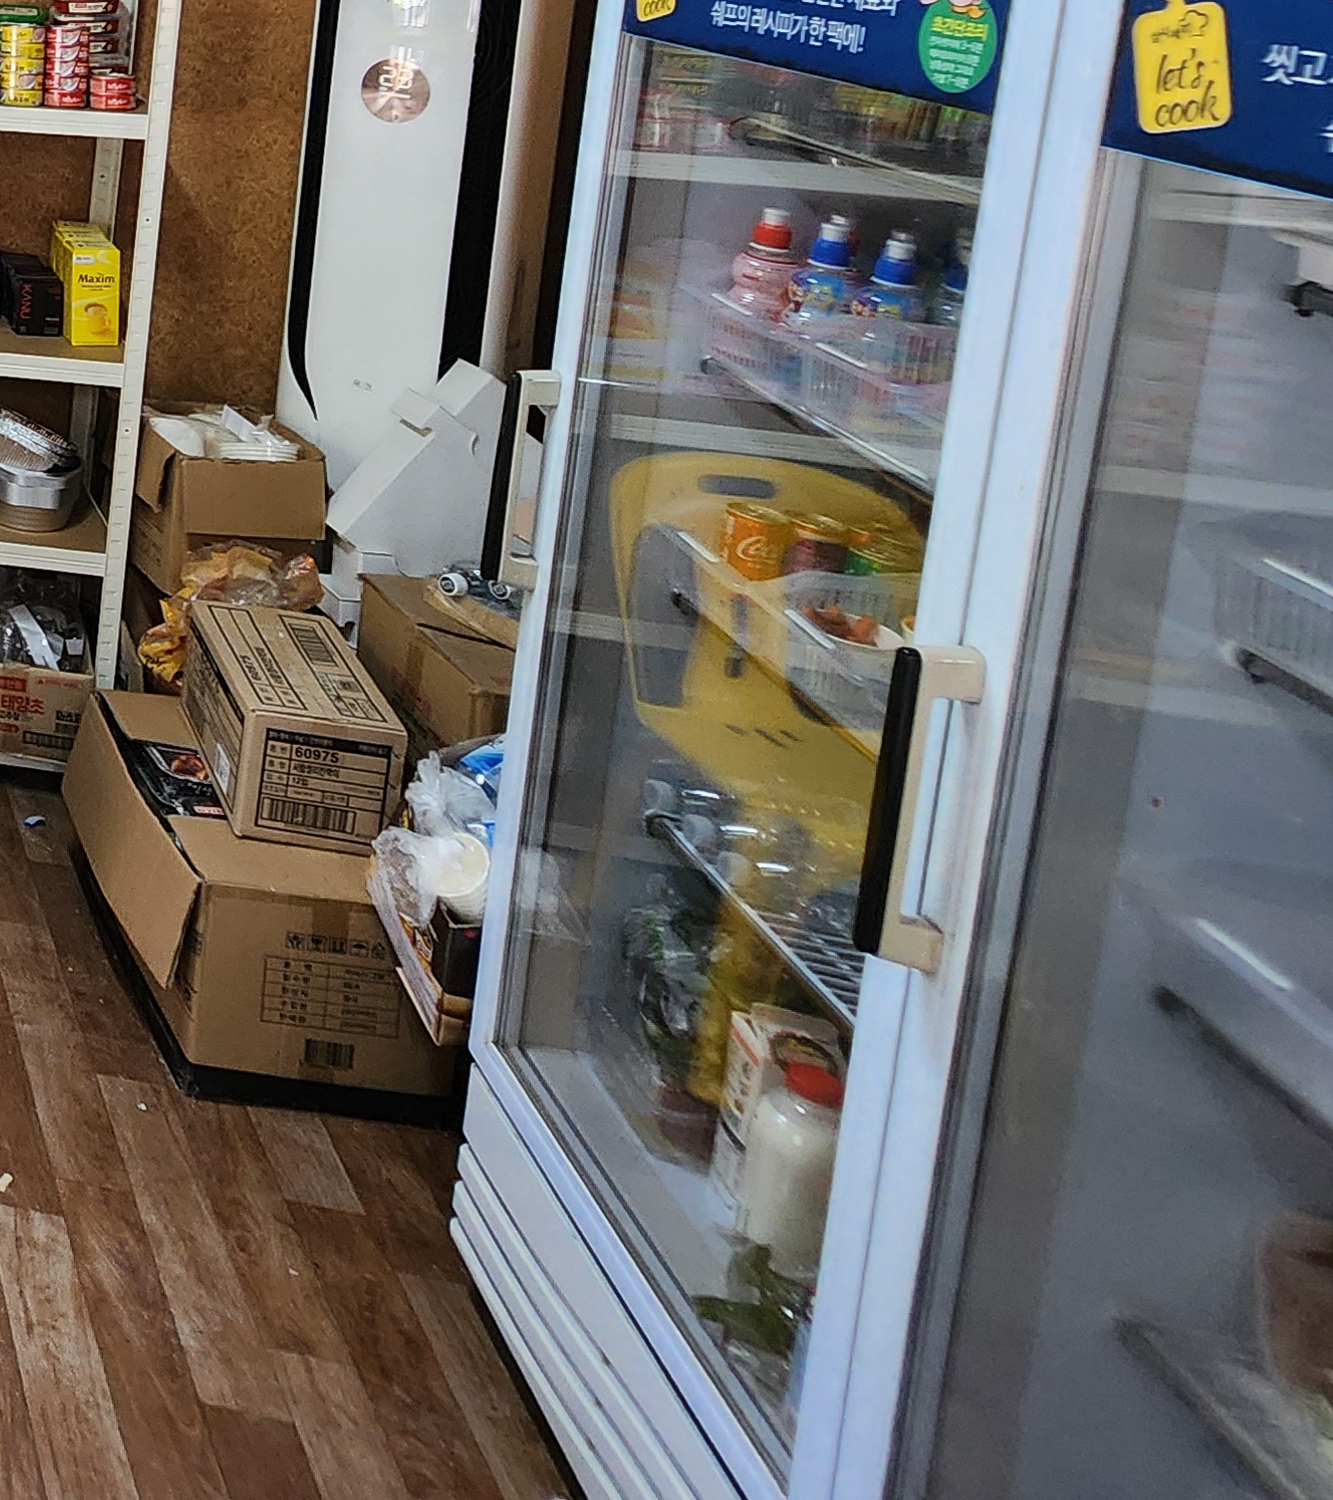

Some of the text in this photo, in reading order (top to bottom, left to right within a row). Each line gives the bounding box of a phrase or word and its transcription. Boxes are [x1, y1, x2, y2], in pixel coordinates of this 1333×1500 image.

[751, 7, 808, 43] 레시피가
[809, 16, 827, 46] 한
[827, 21, 866, 54] 팩에!
[1156, 47, 1205, 94] let's
[1154, 79, 1221, 128] cook
[78, 272, 116, 286] Maxim
[20, 283, 31, 319] KANU
[0, 693, 45, 715] 태양초
[294, 746, 339, 764] 60975
